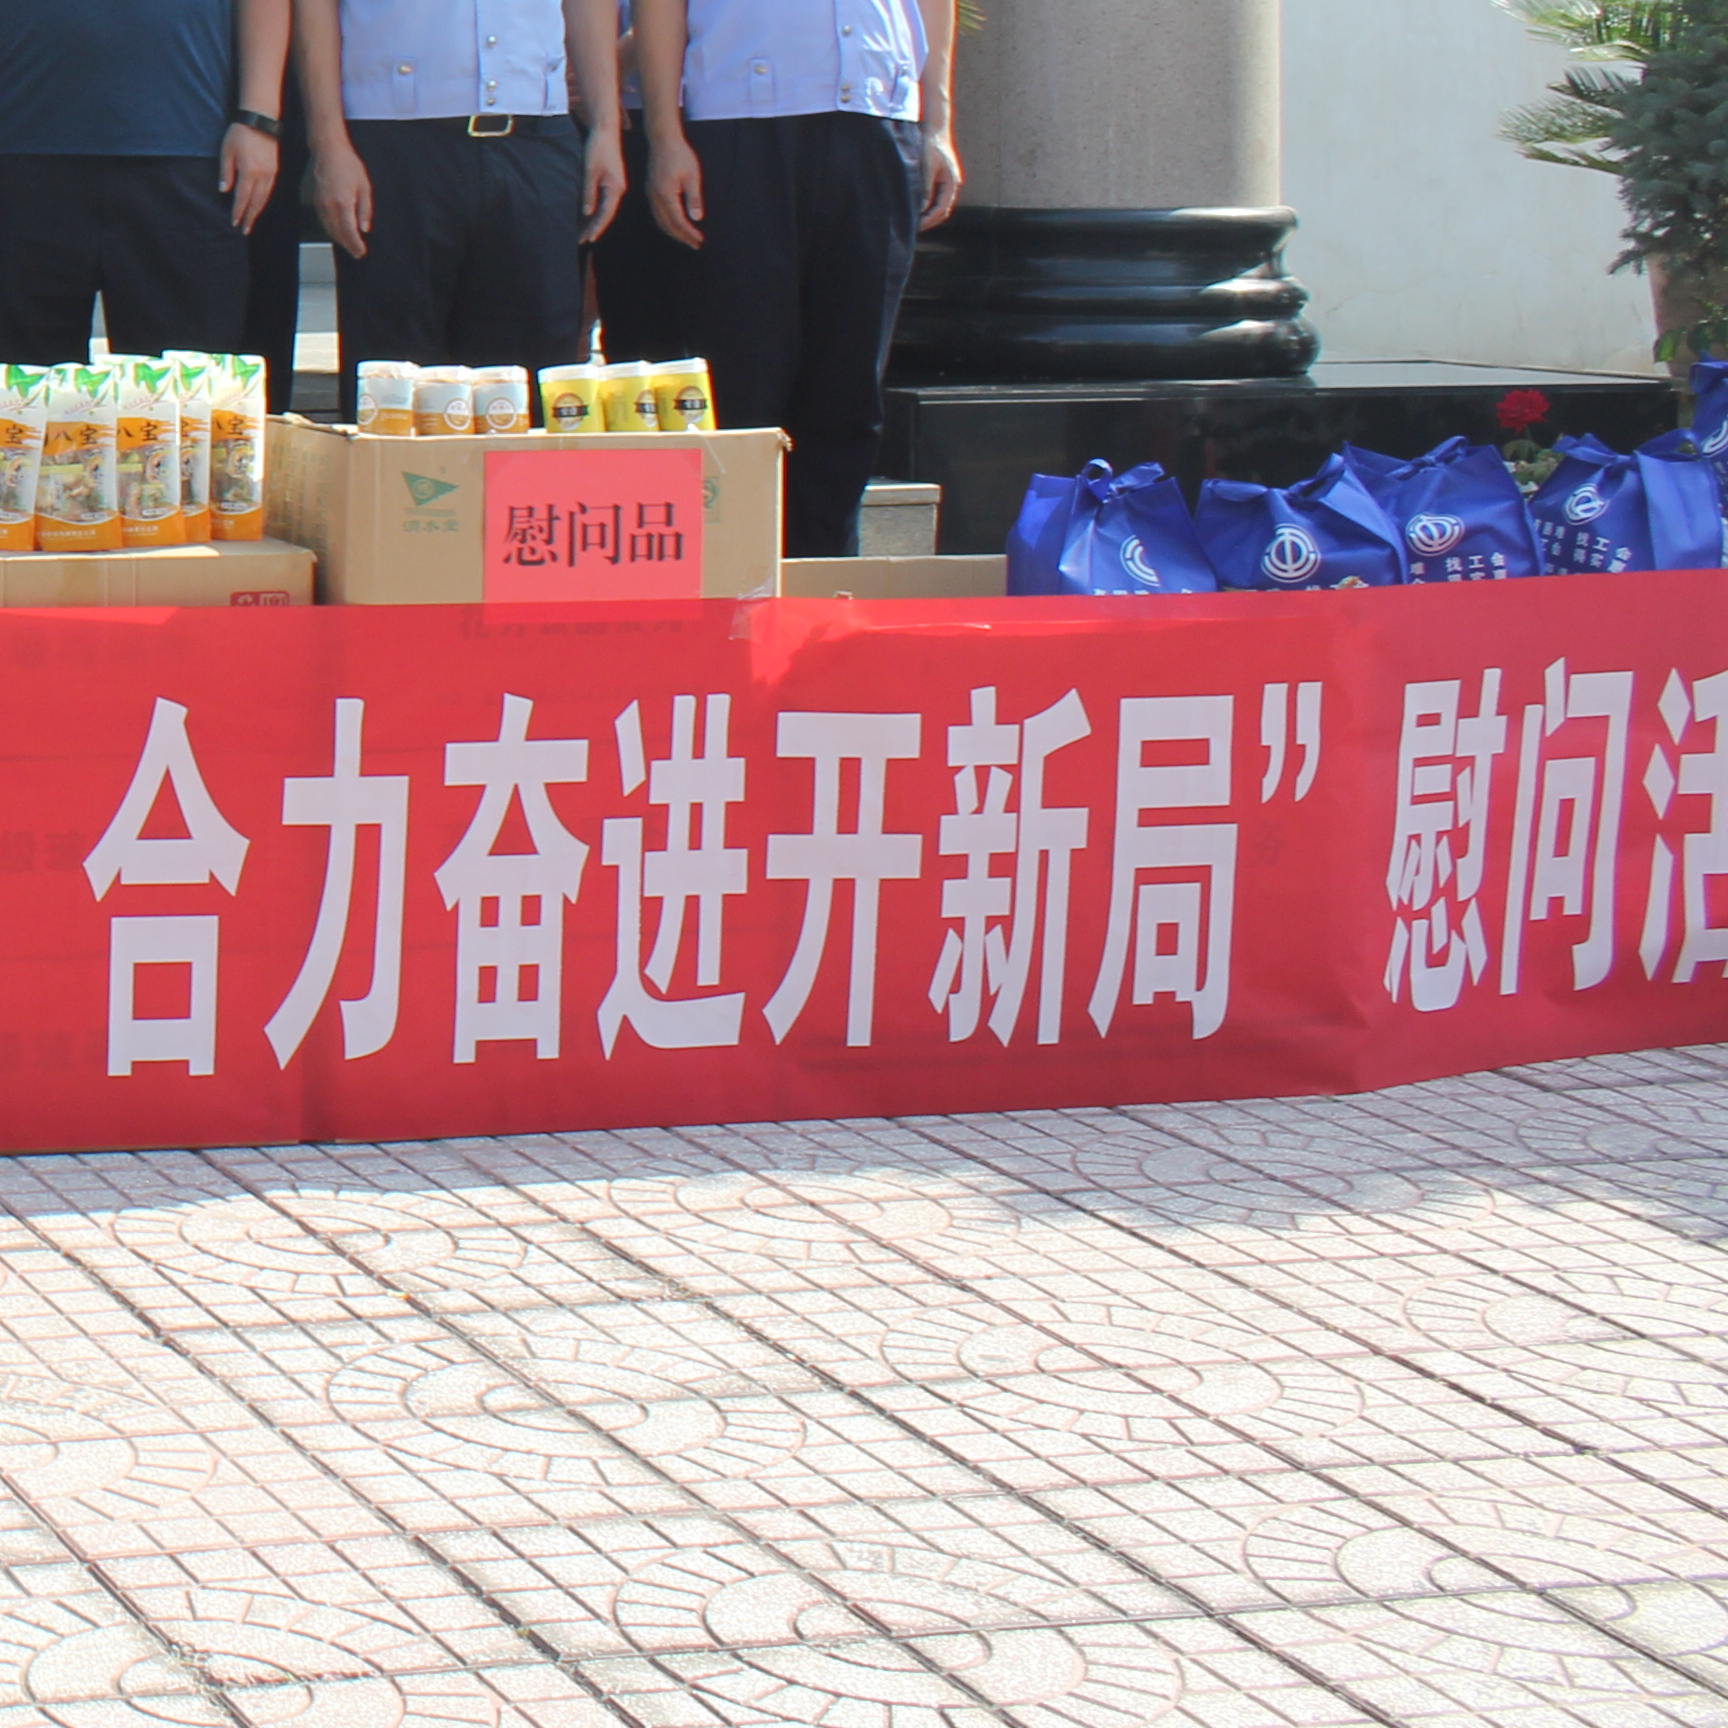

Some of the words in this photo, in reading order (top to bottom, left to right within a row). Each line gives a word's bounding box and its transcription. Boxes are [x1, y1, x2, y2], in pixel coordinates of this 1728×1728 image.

[46, 424, 98, 446] 八宝
[117, 422, 158, 442] 八宝
[502, 500, 684, 567] 慰问品
[1576, 531, 1633, 561] 找工会
[1446, 552, 1505, 572] 找工会
[84, 681, 1323, 1076] 合力奋进开新局”
